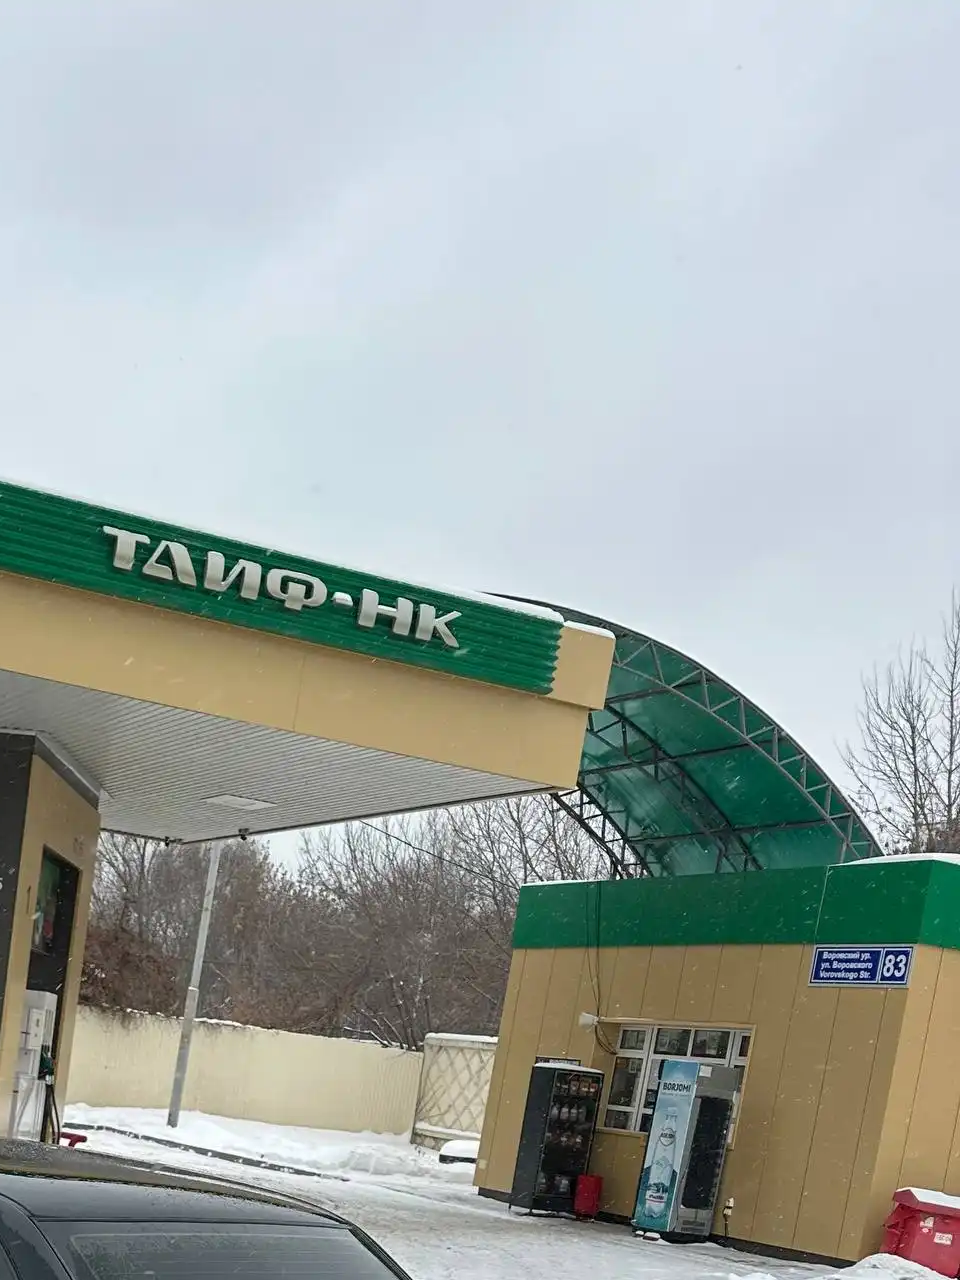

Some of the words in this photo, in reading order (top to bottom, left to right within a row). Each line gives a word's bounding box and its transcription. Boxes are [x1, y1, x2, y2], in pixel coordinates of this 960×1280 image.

[103, 525, 462, 648] ТАИФ-НК
[821, 962, 831, 970] ул.
[832, 961, 873, 970] Воровского
[882, 954, 907, 978] 83
[820, 970, 858, 979] Vorovskogo
[859, 970, 871, 979] Str.
[662, 1082, 692, 1093] BORJOMI
